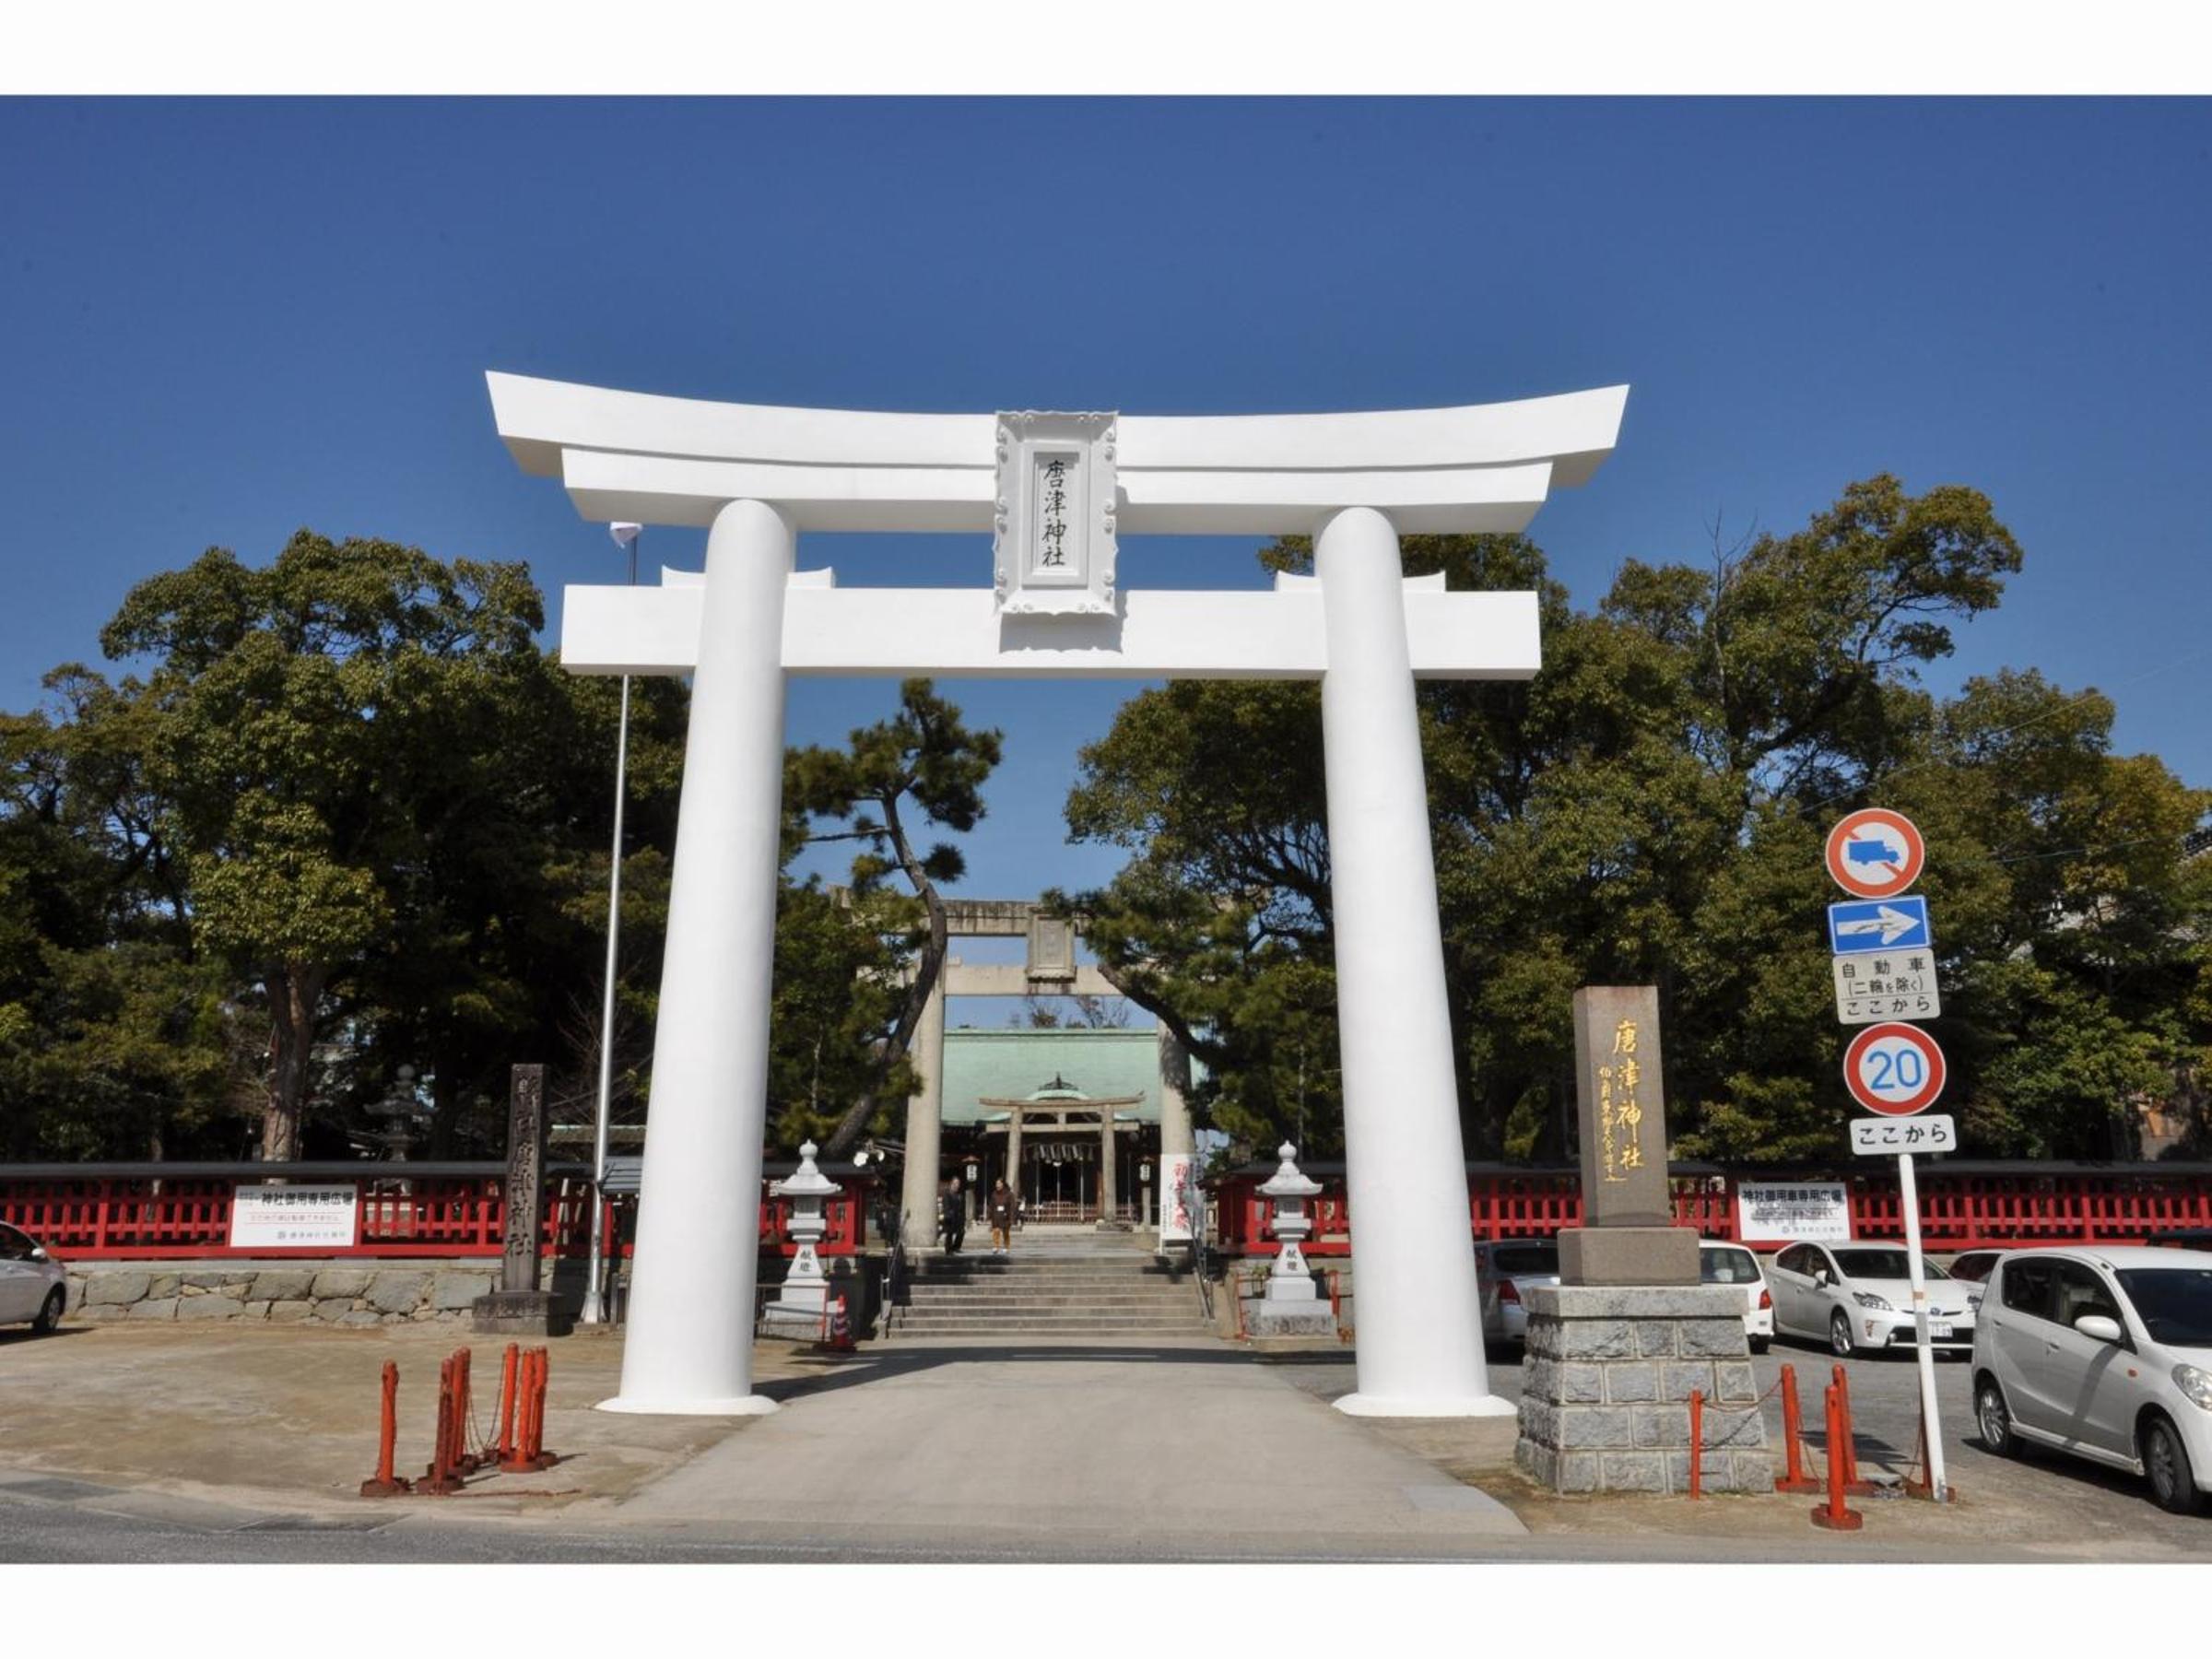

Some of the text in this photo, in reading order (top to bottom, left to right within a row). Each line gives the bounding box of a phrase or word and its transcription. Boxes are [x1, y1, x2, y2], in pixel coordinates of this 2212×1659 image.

[1041, 459, 1067, 567] 唐津神社
[1842, 957, 1926, 979] 自動車
[1848, 975, 1924, 997] (二輪を除く)
[1846, 996, 1931, 1017] ここから
[1866, 1049, 1923, 1090] 20
[1613, 1019, 1644, 1171] 唐津神社
[1858, 1124, 1947, 1146] ここから
